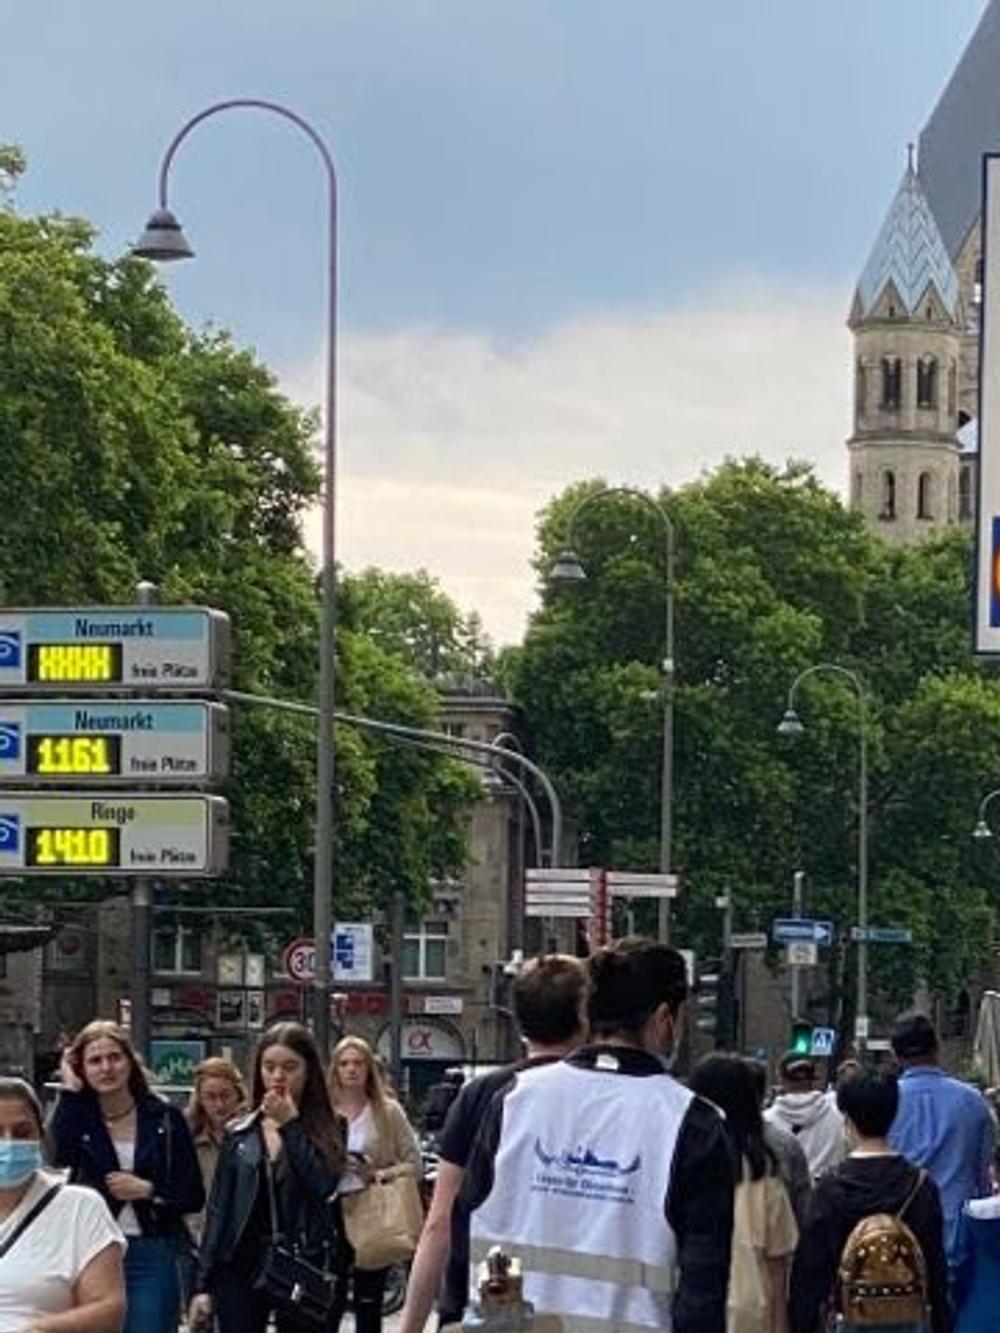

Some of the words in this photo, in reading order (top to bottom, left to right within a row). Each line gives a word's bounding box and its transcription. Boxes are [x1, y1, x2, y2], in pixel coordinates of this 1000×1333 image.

[74, 618, 154, 637] Neumarkt
[74, 711, 154, 730] Neumarkt
[91, 802, 136, 824] Ringe
[35, 829, 109, 865] 1410
